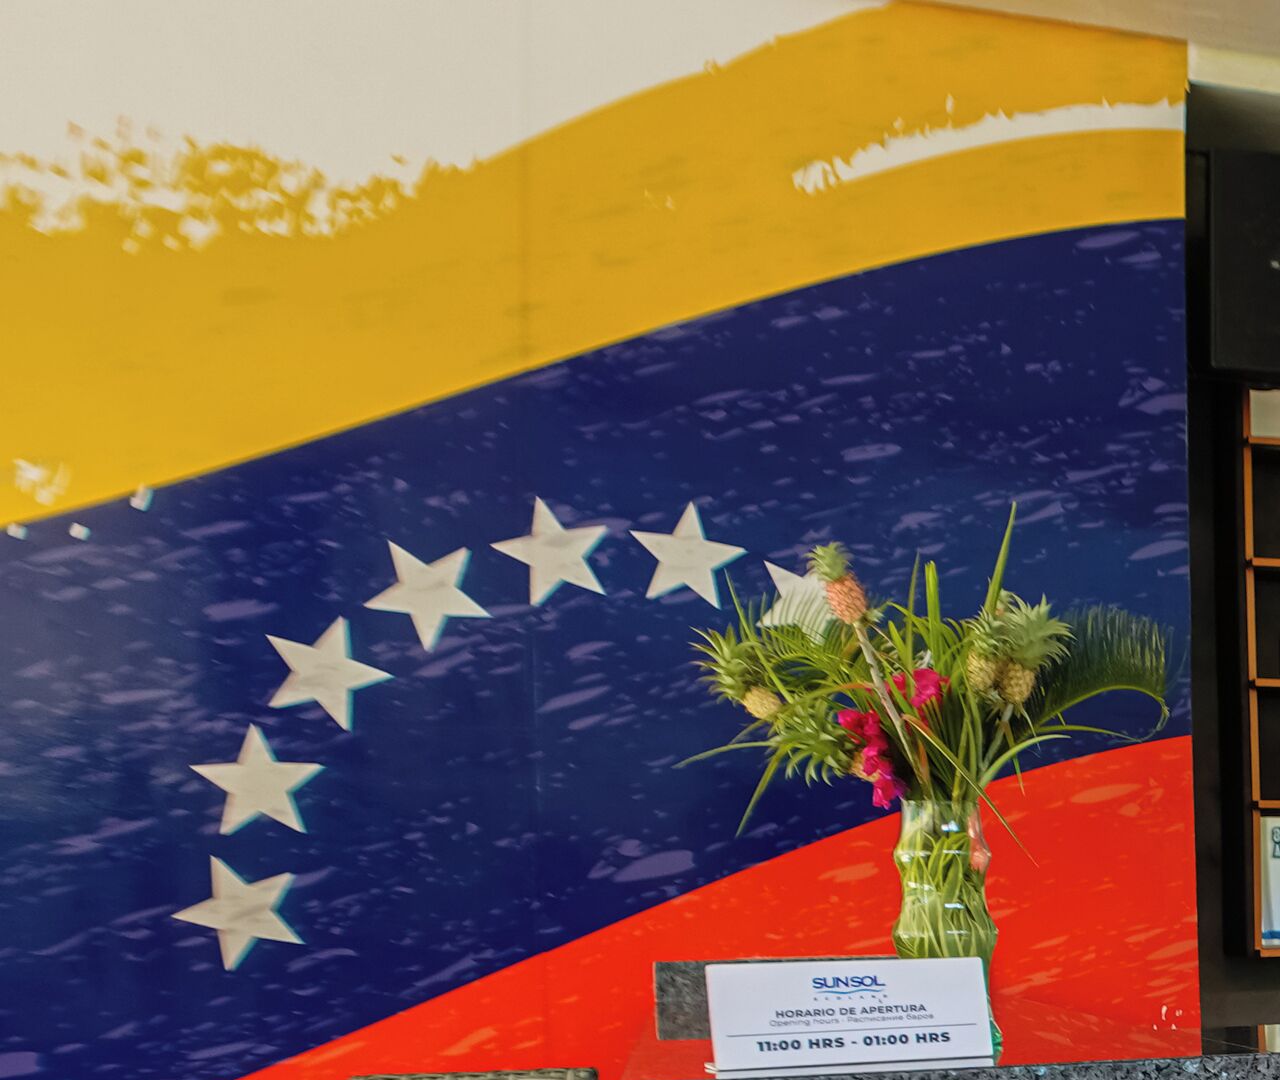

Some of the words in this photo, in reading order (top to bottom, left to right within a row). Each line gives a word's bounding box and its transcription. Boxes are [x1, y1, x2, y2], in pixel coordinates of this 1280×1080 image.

[811, 975, 886, 990] SUNSOL
[775, 1009, 836, 1019] HORARIO
[839, 1007, 856, 1016] DE
[860, 1003, 927, 1015] APERTURA
[769, 1018, 811, 1028] Opening
[813, 1017, 840, 1026] hours
[757, 1039, 801, 1052] 11:00
[808, 1037, 845, 1050] HRS
[863, 1033, 910, 1047] 01:00
[915, 1031, 951, 1044] HRS
